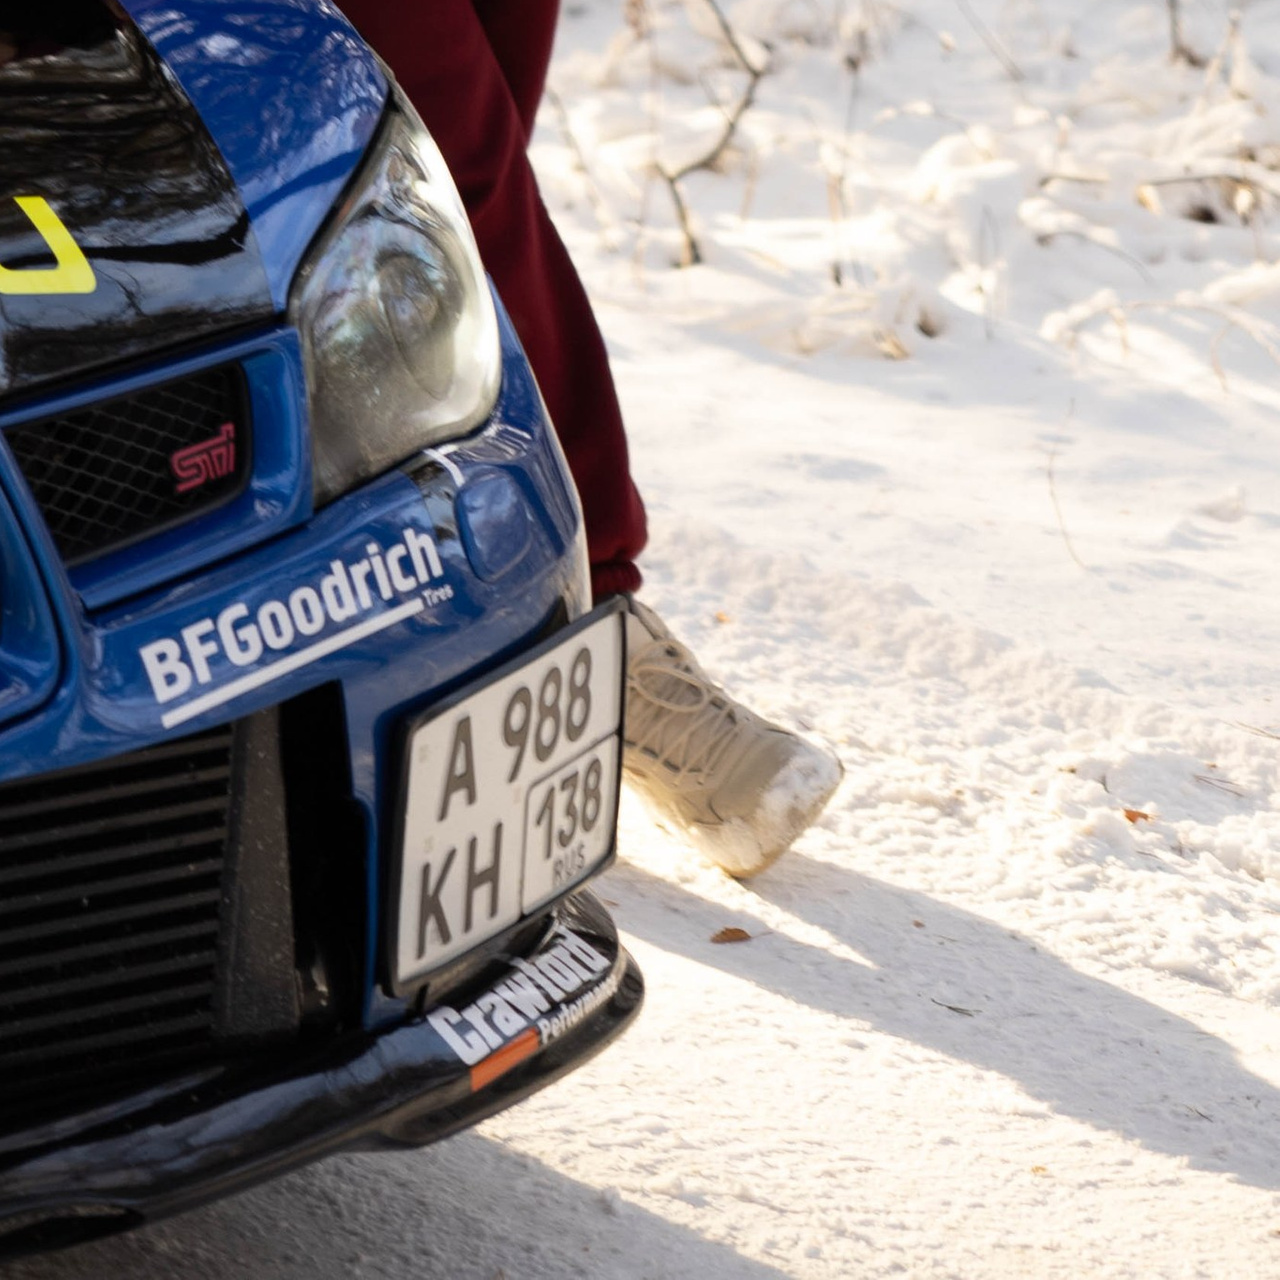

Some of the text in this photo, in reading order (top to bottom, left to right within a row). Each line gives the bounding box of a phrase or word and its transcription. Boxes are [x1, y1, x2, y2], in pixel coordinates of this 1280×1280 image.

[139, 527, 443, 704] BFGoodrich
[422, 583, 455, 608] Tires
[503, 647, 592, 784] 988
[535, 757, 603, 861] 138
[551, 843, 587, 887] RUS
[426, 924, 612, 1066] Crawford
